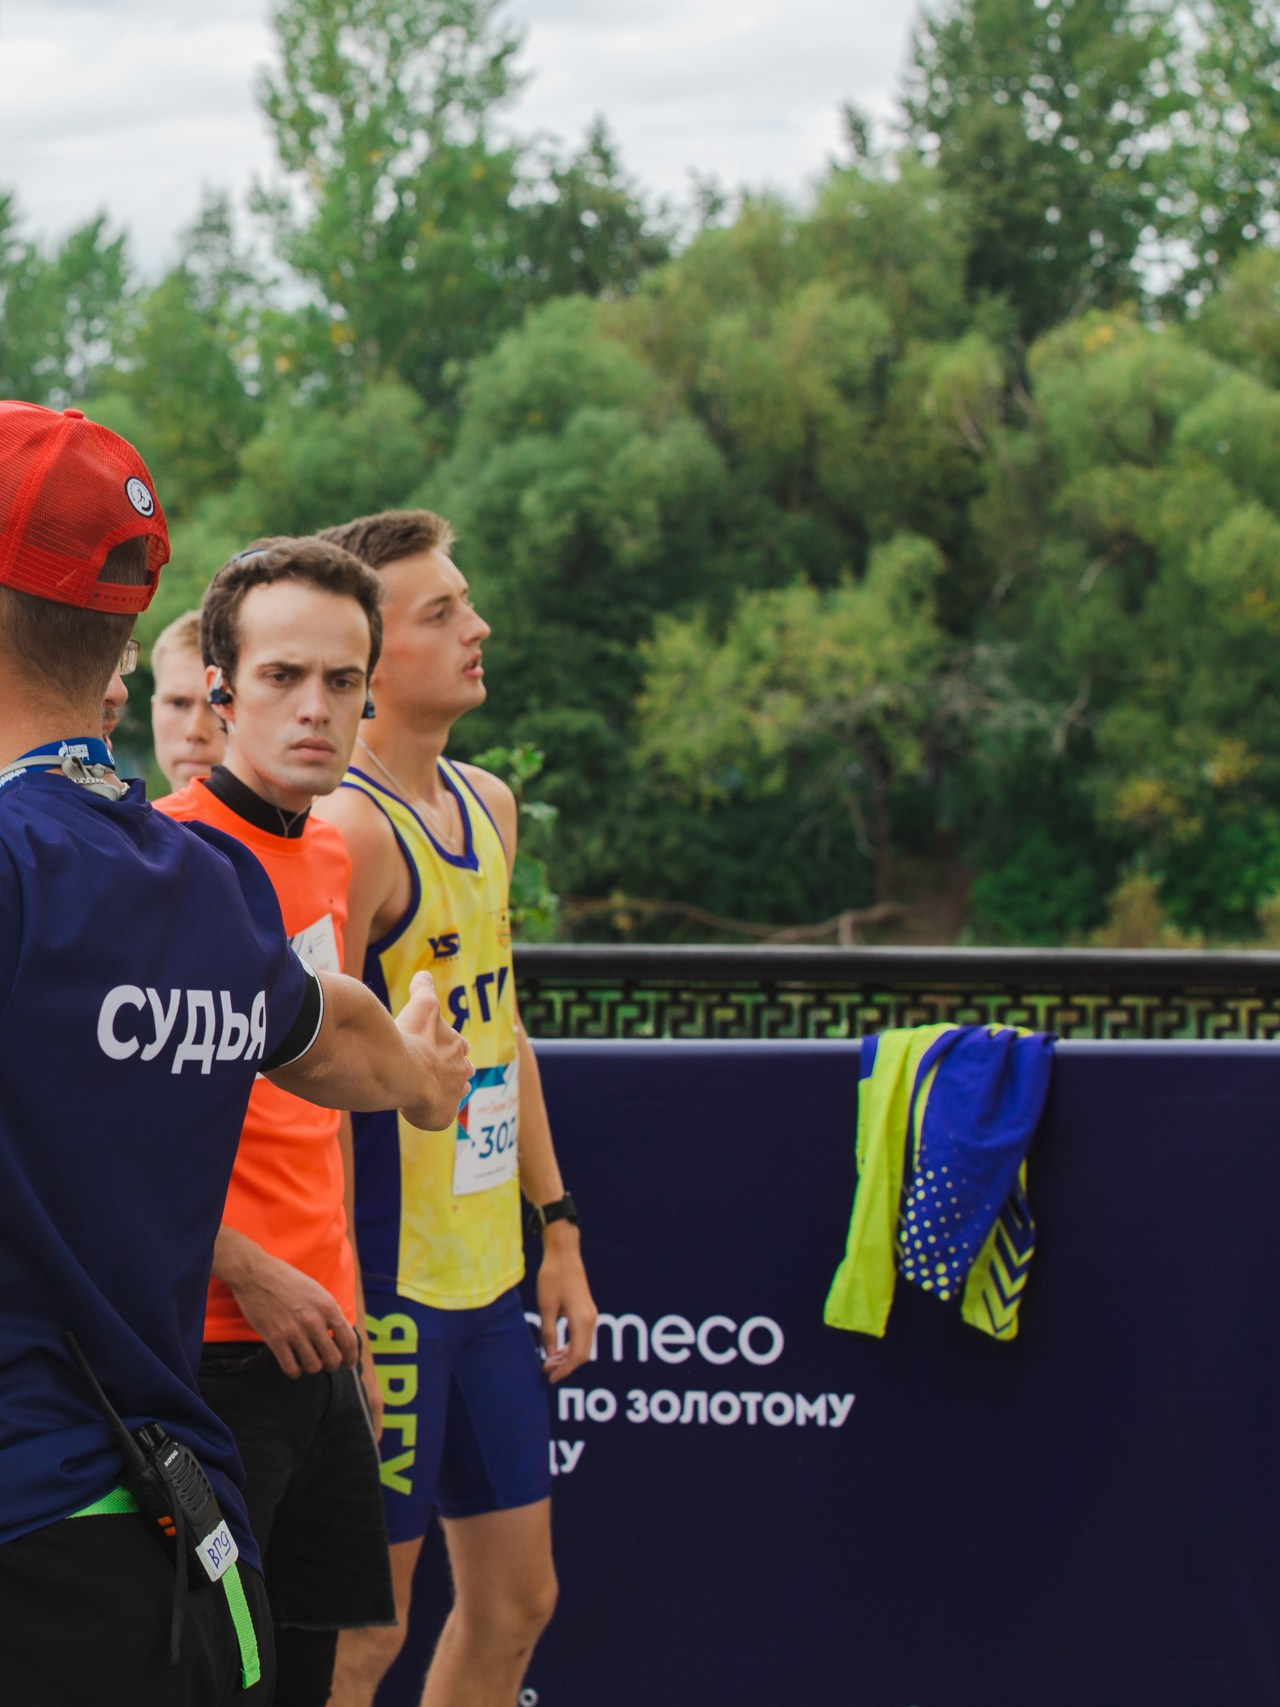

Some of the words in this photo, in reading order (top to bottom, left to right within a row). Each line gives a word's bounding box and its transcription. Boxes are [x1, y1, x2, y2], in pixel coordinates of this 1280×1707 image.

[96, 984, 267, 1075] СУДЬЯ
[558, 1387, 617, 1423] ПО
[626, 1388, 856, 1428] ЗОЛОТОМУ
